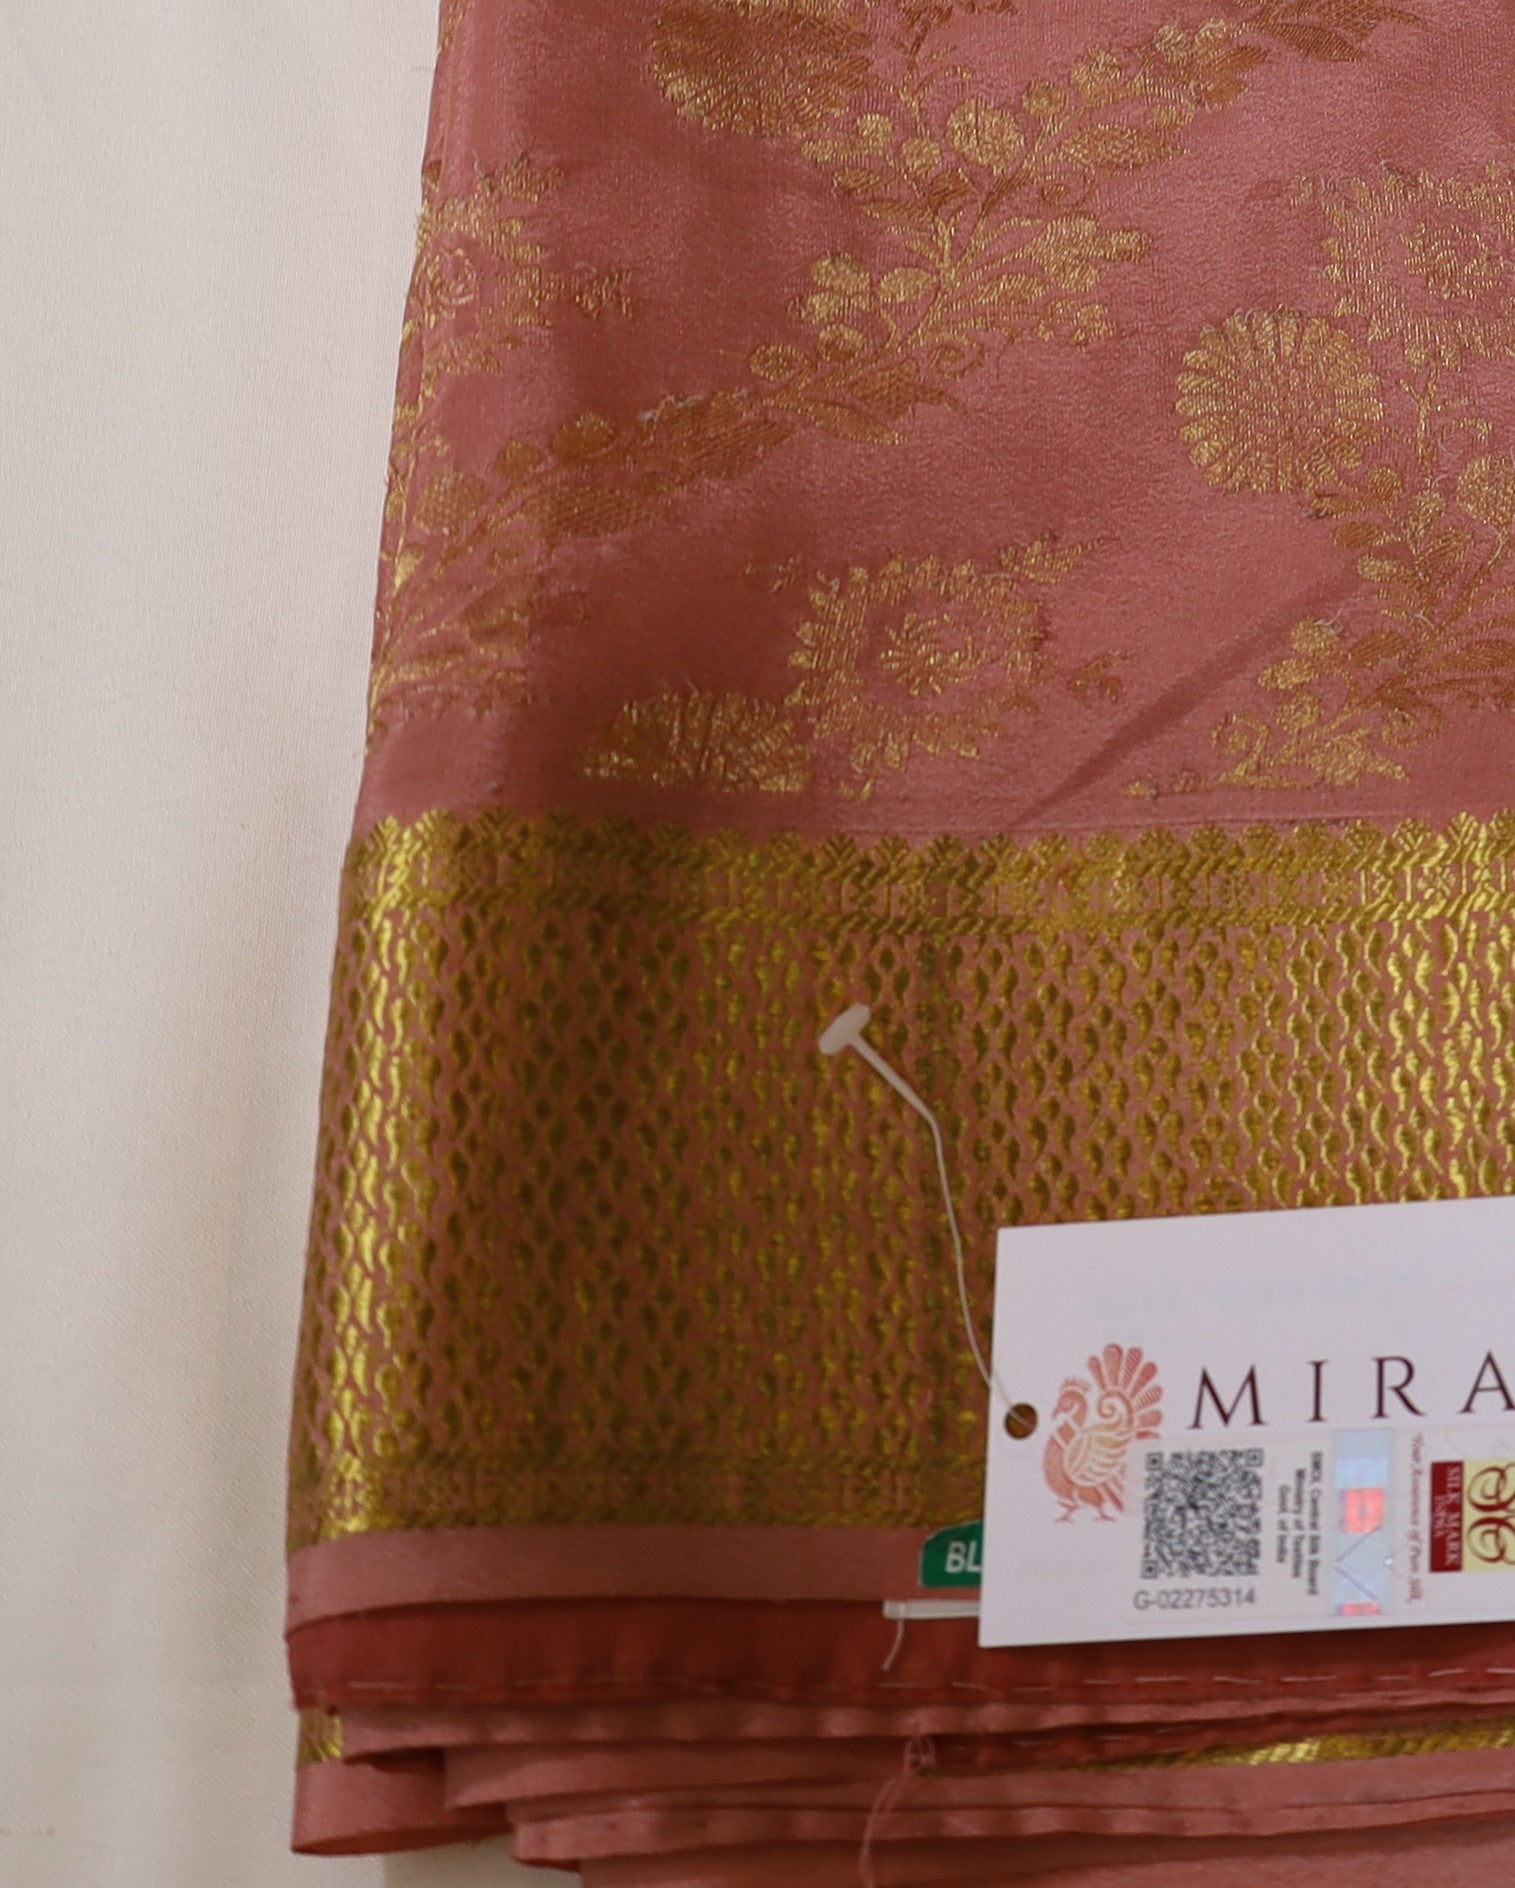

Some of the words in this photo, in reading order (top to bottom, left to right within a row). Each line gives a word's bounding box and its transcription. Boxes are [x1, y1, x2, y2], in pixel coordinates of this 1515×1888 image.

[1446, 1466, 1462, 1504] SILK
[1445, 1511, 1461, 1566] MARK
[1133, 1587, 1256, 1610] G-02275314
